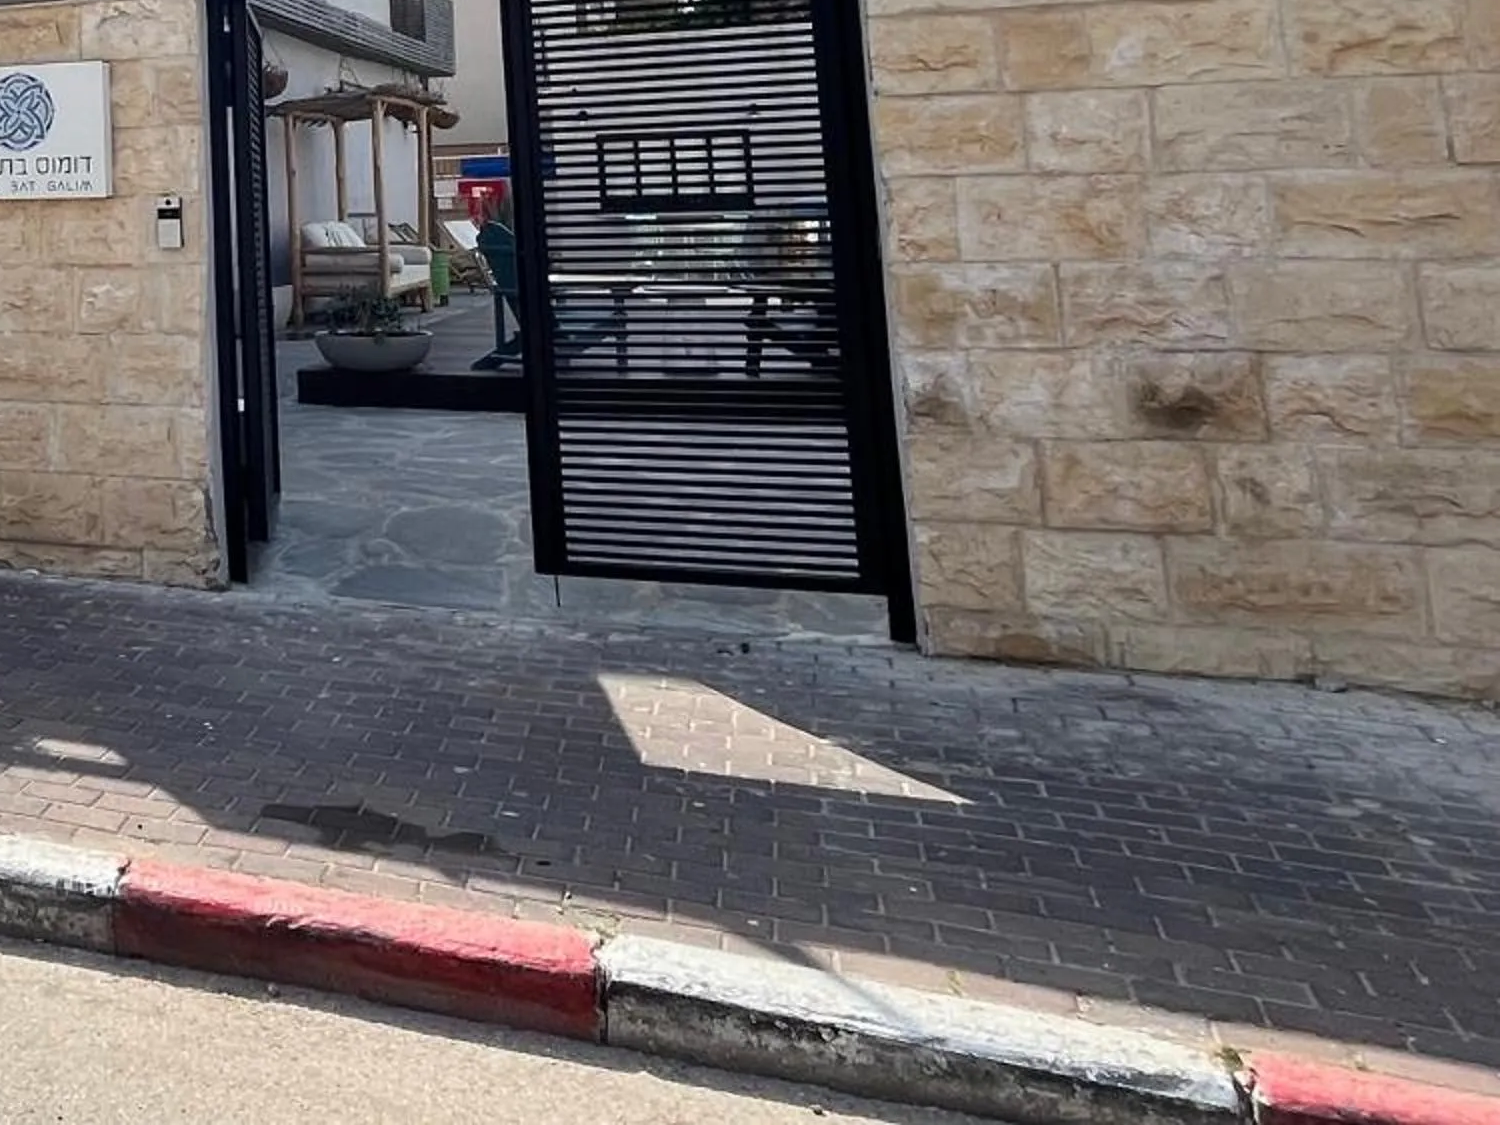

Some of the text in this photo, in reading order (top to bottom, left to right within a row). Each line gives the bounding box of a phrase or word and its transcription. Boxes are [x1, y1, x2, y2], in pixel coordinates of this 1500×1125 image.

[35, 156, 92, 175] דומוס
[10, 180, 36, 192] BAT
[47, 180, 93, 192] GALIM
